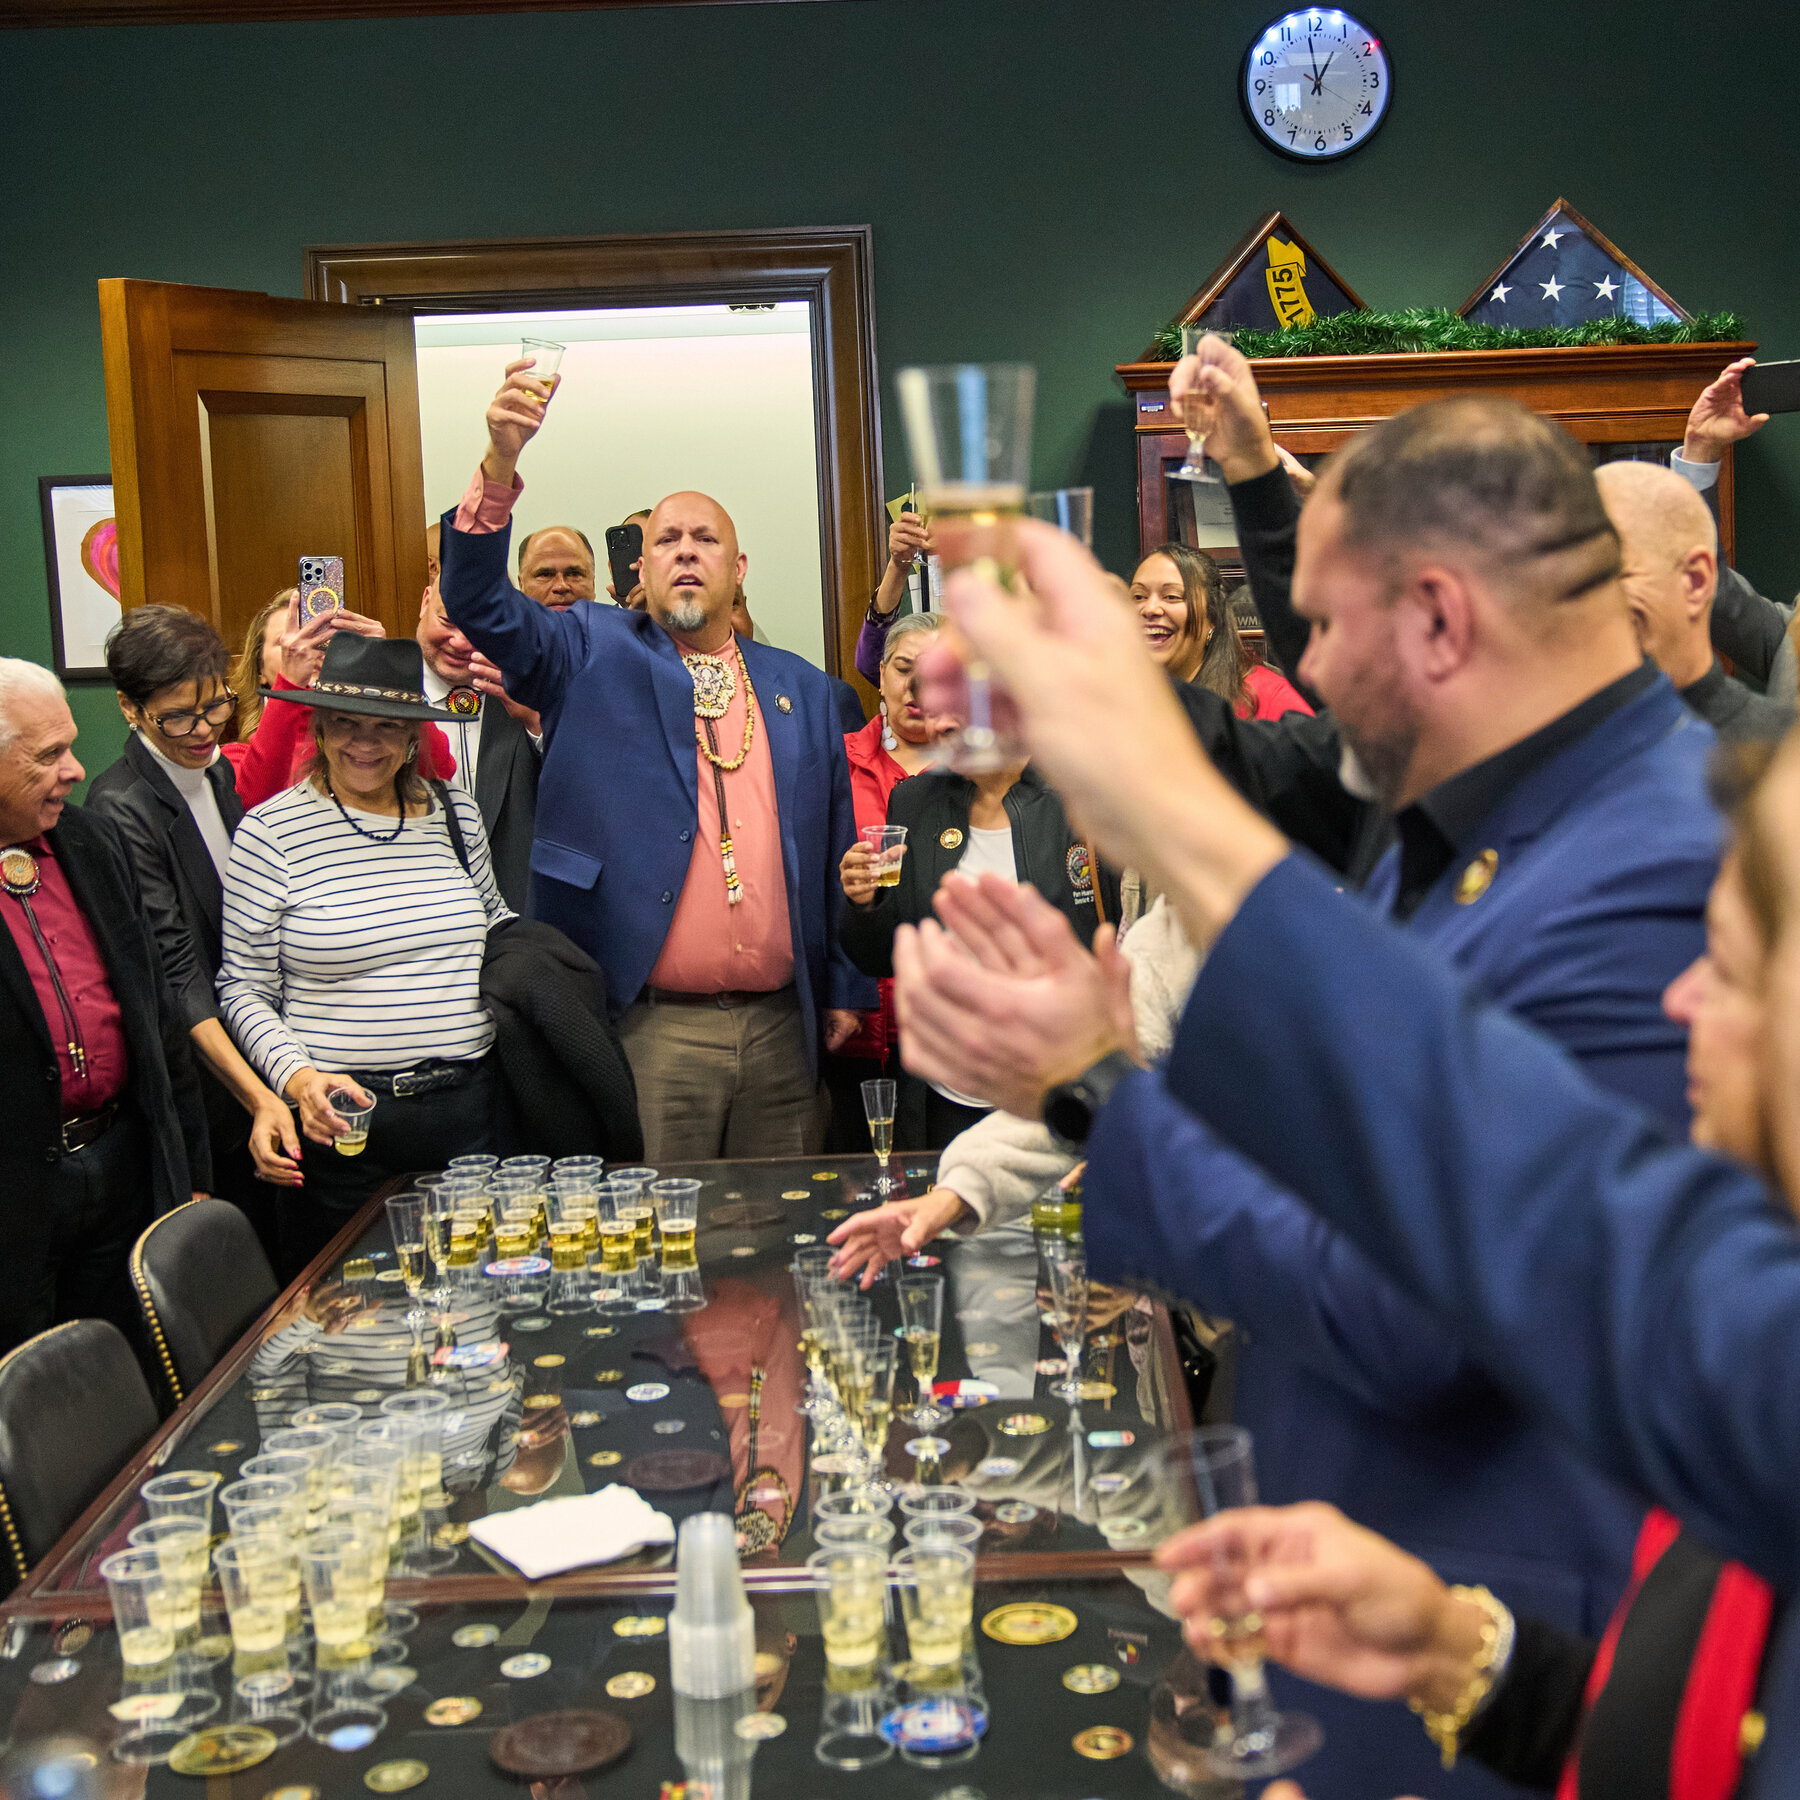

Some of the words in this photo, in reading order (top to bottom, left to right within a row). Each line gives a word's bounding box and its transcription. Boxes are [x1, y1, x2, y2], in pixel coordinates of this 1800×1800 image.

[1308, 16, 1323, 32] 12
[1343, 24, 1347, 38] 1
[1280, 27, 1291, 42] 11
[1362, 41, 1372, 57] 2
[1260, 51, 1274, 66] 10
[1254, 78, 1266, 96] 9
[1370, 72, 1379, 88] 3
[1360, 100, 1373, 116] 4
[1264, 109, 1275, 126] 8
[1287, 130, 1297, 145] 7
[1343, 125, 1353, 141] 5
[1314, 135, 1326, 151] 6
[1272, 268, 1304, 323] 1775
